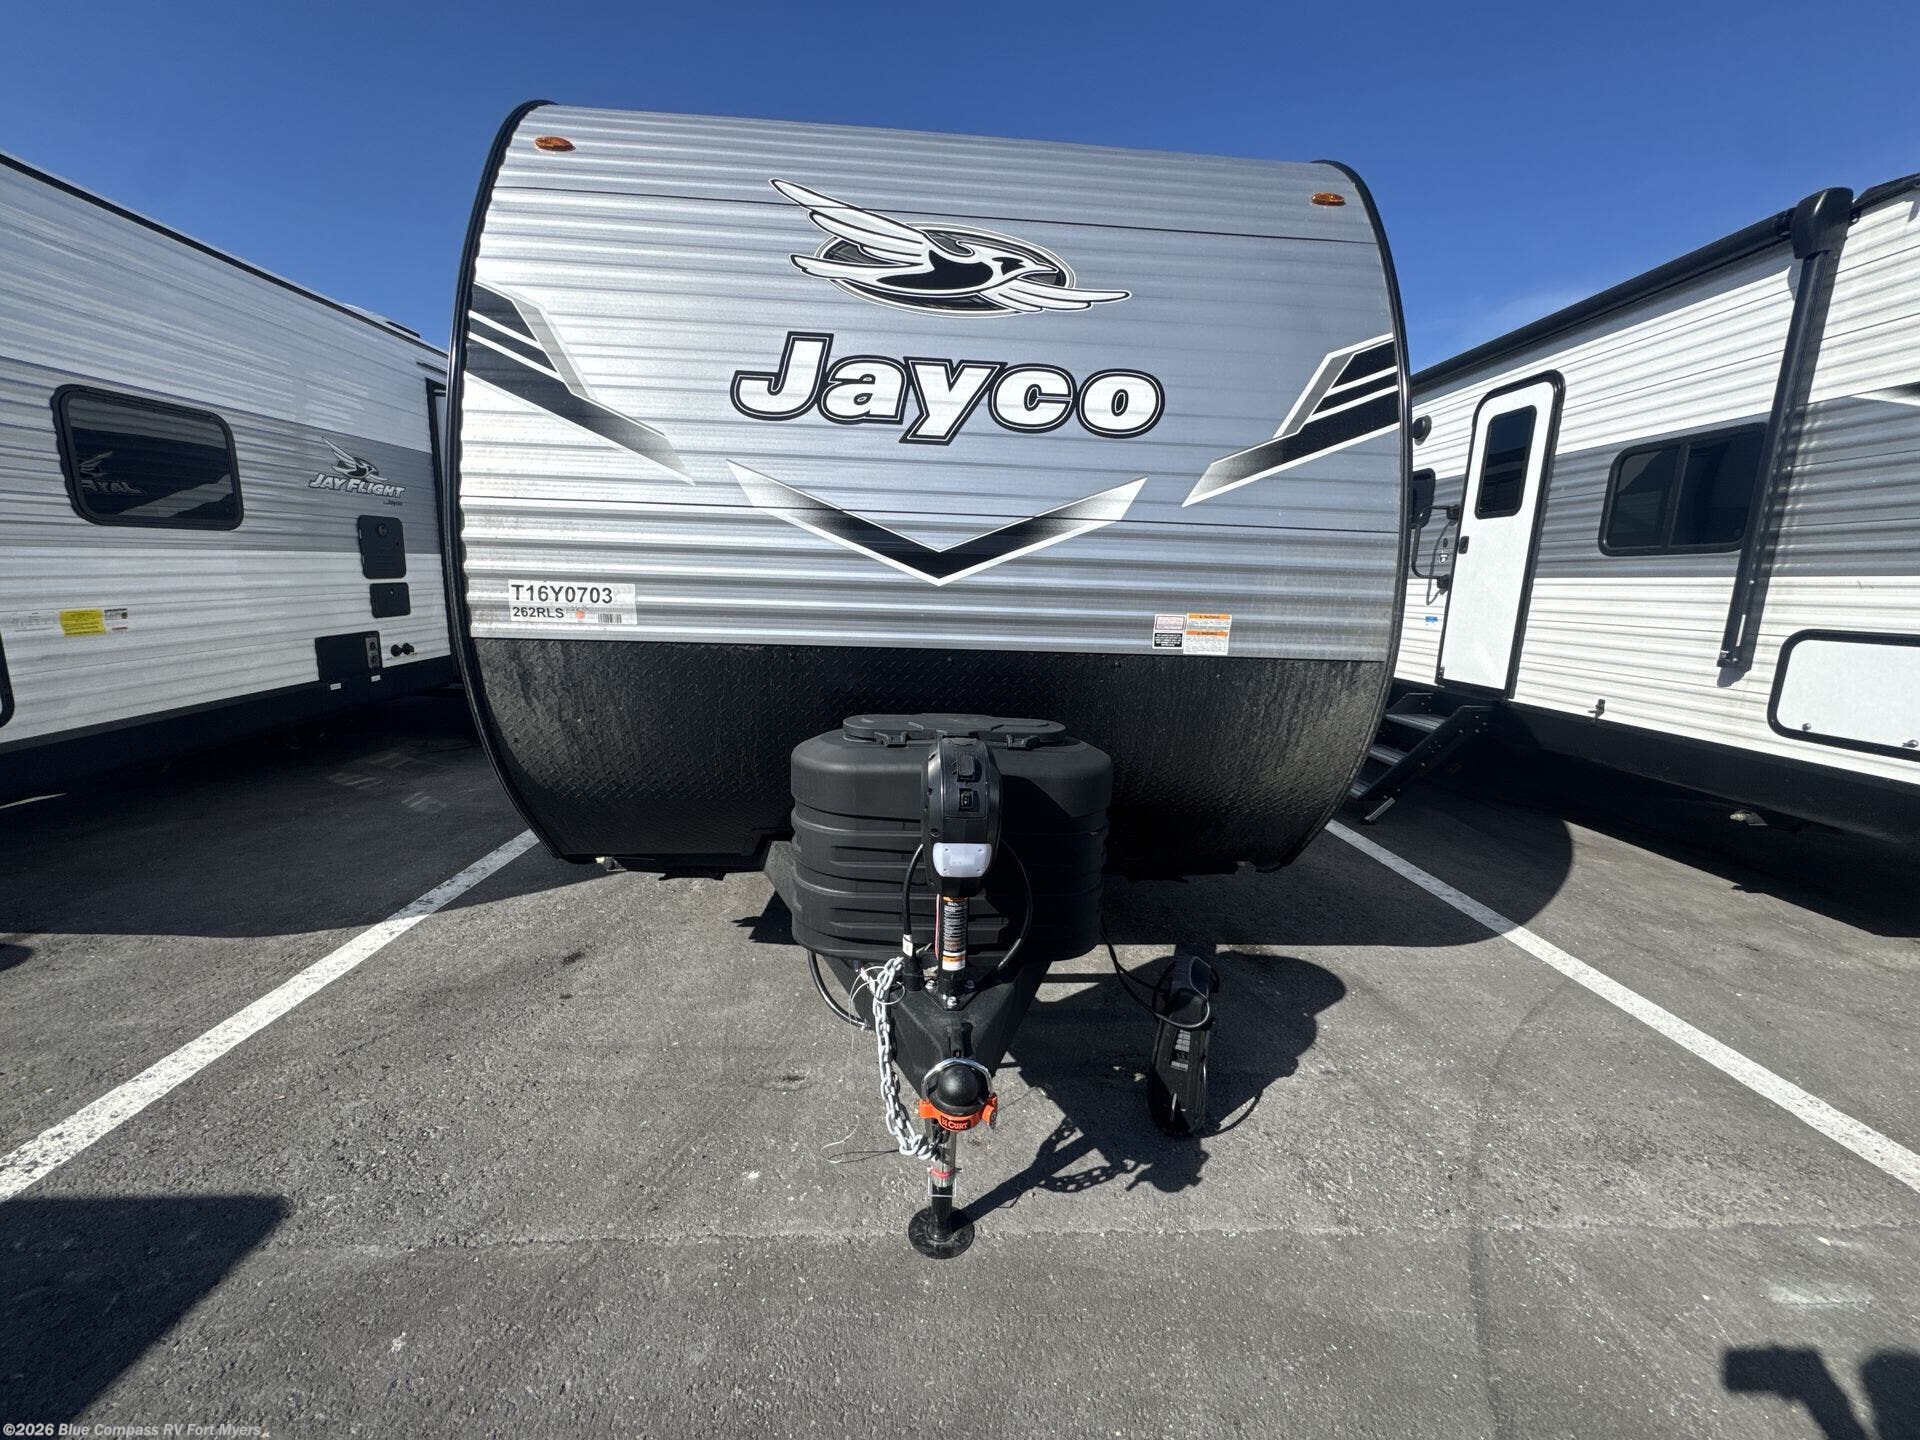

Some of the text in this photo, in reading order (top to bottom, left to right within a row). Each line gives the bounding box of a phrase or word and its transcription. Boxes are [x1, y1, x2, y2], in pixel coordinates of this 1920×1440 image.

[730, 331, 1165, 446] Jayco
[309, 473, 406, 498] JAY FLIGHT
[511, 584, 613, 604] T16Y0703
[513, 606, 564, 618] 262RLS
